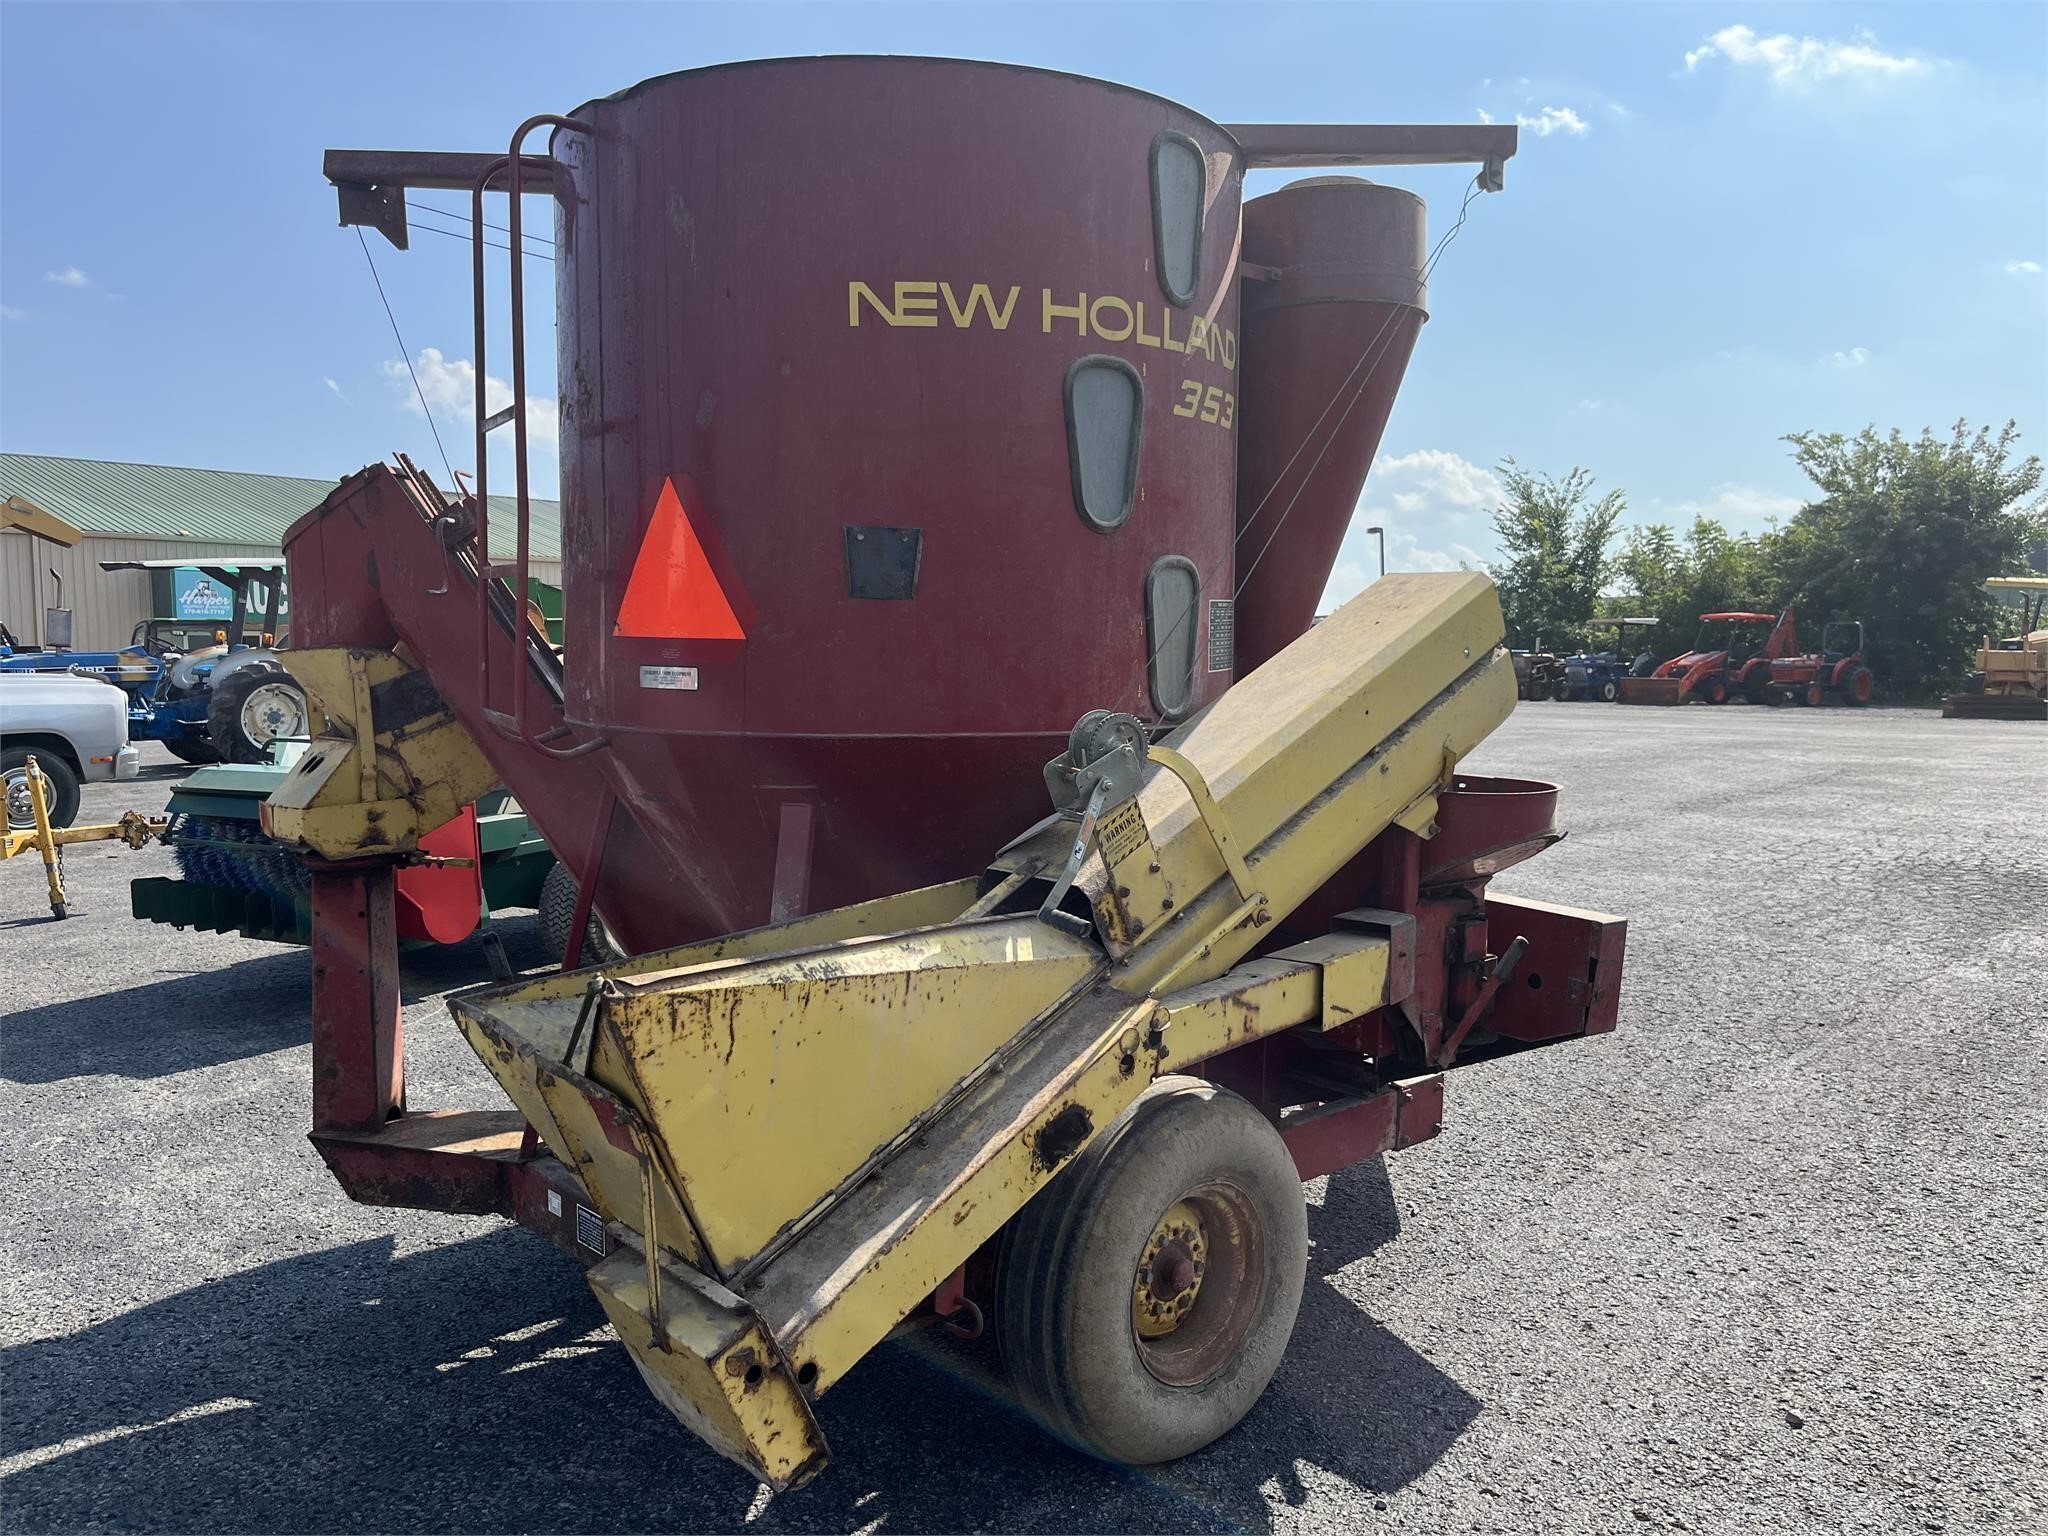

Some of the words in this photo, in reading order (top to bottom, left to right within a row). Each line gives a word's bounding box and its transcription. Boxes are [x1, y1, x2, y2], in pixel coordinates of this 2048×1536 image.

[849, 281, 1021, 330] NEW
[1042, 288, 1236, 371] HOLLAND
[1173, 379, 1235, 430] 353
[179, 588, 231, 609] Harper
[1105, 814, 1137, 844] WARNING
